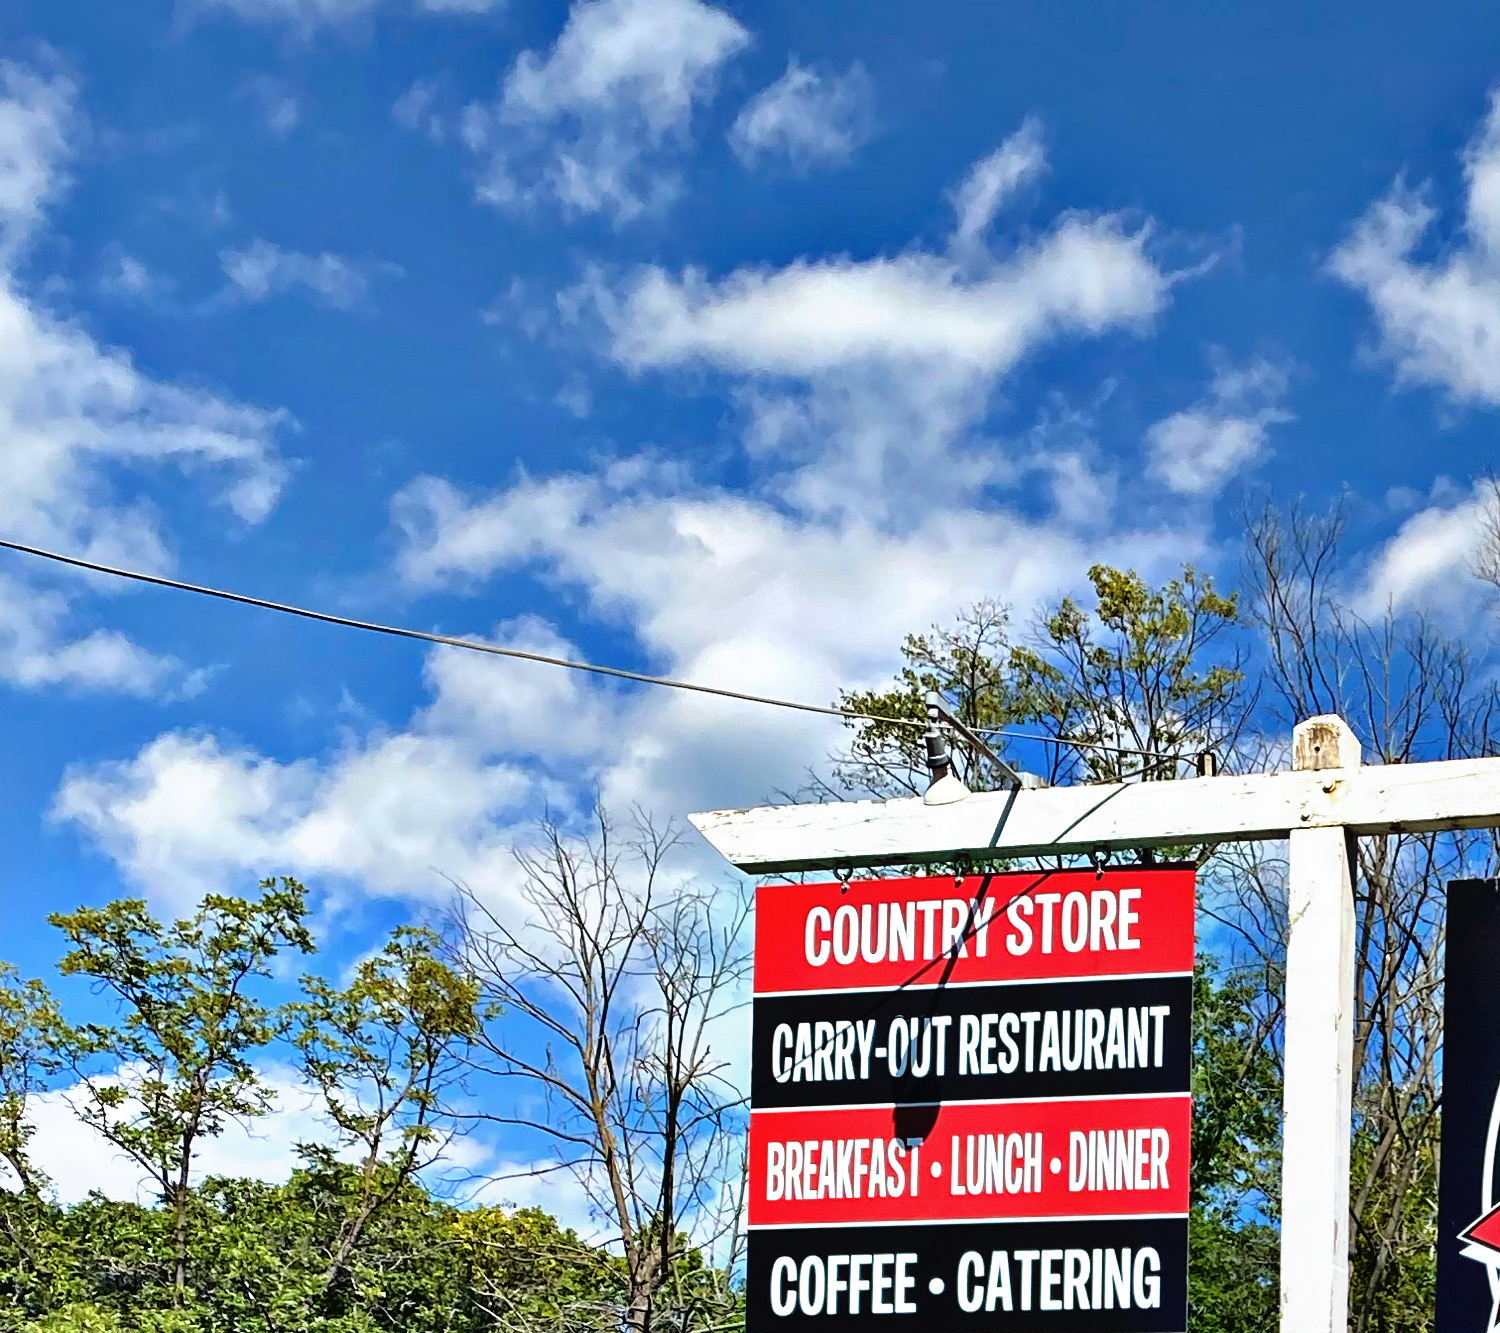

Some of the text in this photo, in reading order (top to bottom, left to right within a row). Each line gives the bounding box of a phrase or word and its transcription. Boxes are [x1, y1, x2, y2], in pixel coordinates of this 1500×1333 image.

[804, 888, 1142, 967] COUNTRY STORE
[772, 1005, 1171, 1085] CARRY-OUT RESTAURANT
[766, 1127, 1170, 1201] BREAKFAST LUNCH DINNER
[770, 1246, 1161, 1317] COFFEE CATERING
